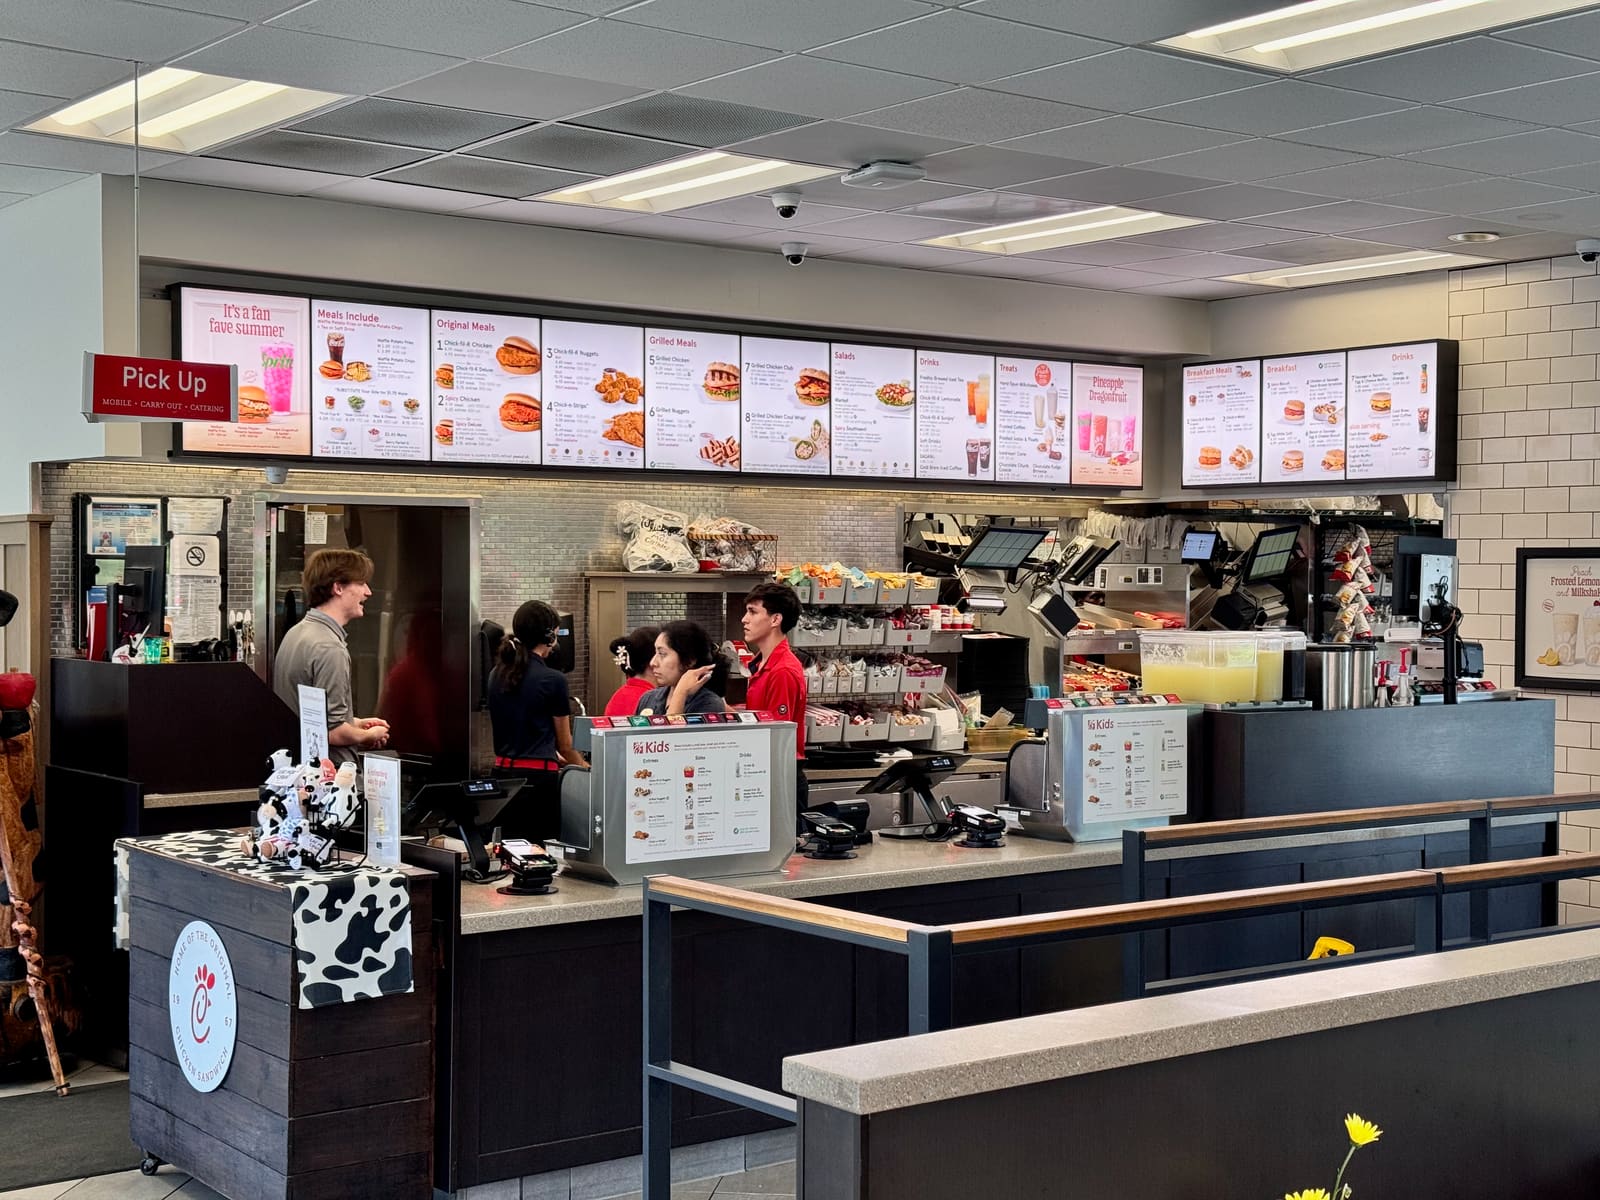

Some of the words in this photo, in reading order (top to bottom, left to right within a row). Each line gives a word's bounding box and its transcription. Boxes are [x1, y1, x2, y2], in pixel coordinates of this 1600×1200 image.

[224, 304, 240, 318] It's
[243, 307, 249, 319] a
[252, 305, 270, 321] fan
[318, 309, 343, 319] Meals
[346, 312, 379, 322] Include
[209, 318, 233, 333] fave
[236, 322, 285, 337] summer
[437, 319, 469, 330] Original
[472, 322, 495, 331] Meals
[437, 340, 443, 350] 1
[649, 336, 674, 346] Grilled
[676, 339, 697, 348] Meals
[547, 348, 553, 358] 3
[835, 352, 855, 360] Salads
[1392, 353, 1414, 361] Drinks
[649, 355, 655, 365] 5
[920, 358, 939, 366] Drinks
[745, 363, 750, 372] 7
[1000, 364, 1017, 372] Treats
[1186, 368, 1214, 377] Breakfast
[1267, 365, 1296, 373] Breakfast
[123, 366, 171, 390] Pick
[178, 371, 207, 398] Up
[1092, 376, 1124, 390] Pineapple
[438, 395, 444, 406] 2
[1089, 390, 1128, 404] Dragonfruit
[102, 398, 132, 406] MOBILE
[140, 401, 166, 409] CARRY
[167, 402, 182, 410] OUT
[190, 404, 224, 413] CATERING
[547, 402, 553, 412] 4
[649, 407, 655, 417] 6
[745, 413, 750, 422] 8
[1570, 565, 1592, 576] Peach
[1551, 577, 1576, 586] Frosted
[1097, 720, 1114, 729] Kids
[646, 741, 670, 753] Kids
[174, 942, 186, 977] HOME
[186, 932, 195, 943] OF
[196, 931, 209, 942] THE
[209, 938, 232, 1000] ORIGINAL
[172, 994, 180, 1005] 19
[224, 1016, 232, 1028] 67
[175, 1026, 196, 1077] CHICKEN
[197, 1046, 227, 1082] SANDWICH
